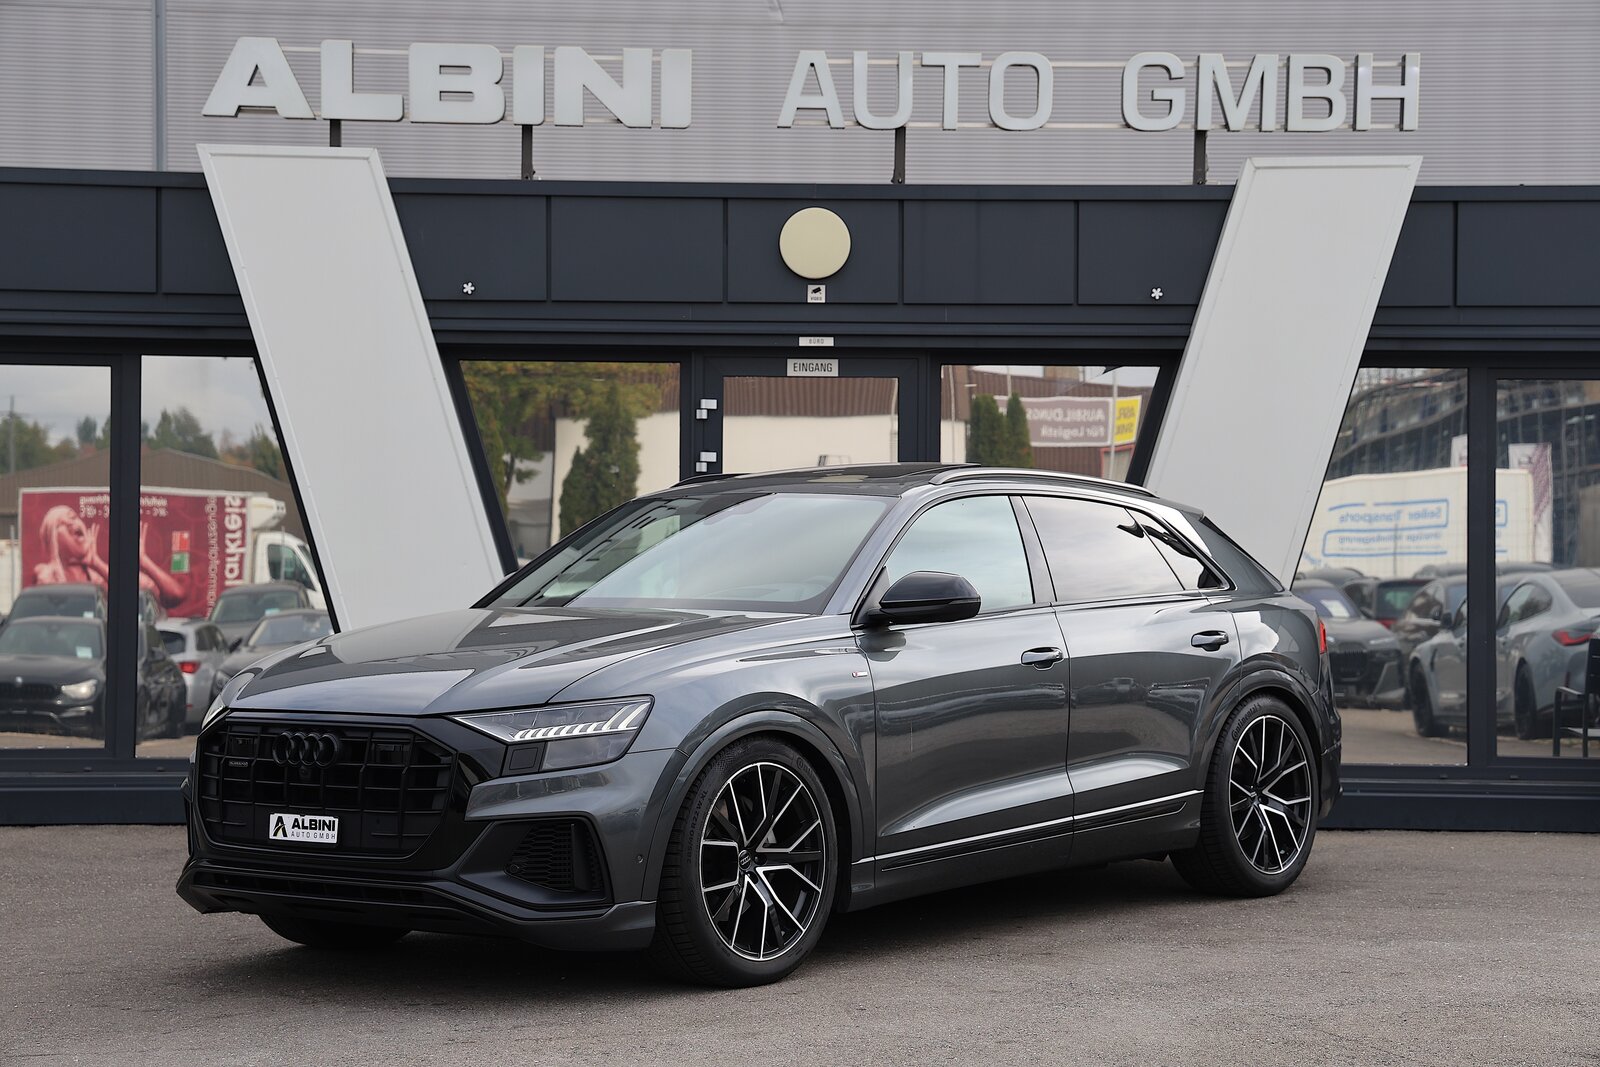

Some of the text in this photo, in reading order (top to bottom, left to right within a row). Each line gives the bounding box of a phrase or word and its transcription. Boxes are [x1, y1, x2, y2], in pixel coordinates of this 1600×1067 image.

[202, 36, 1421, 133] ALBINI AUTO GMBH
[793, 362, 833, 373] EINGANG
[291, 817, 336, 832] ALBINI
[291, 831, 336, 840] AUTO GMBH
